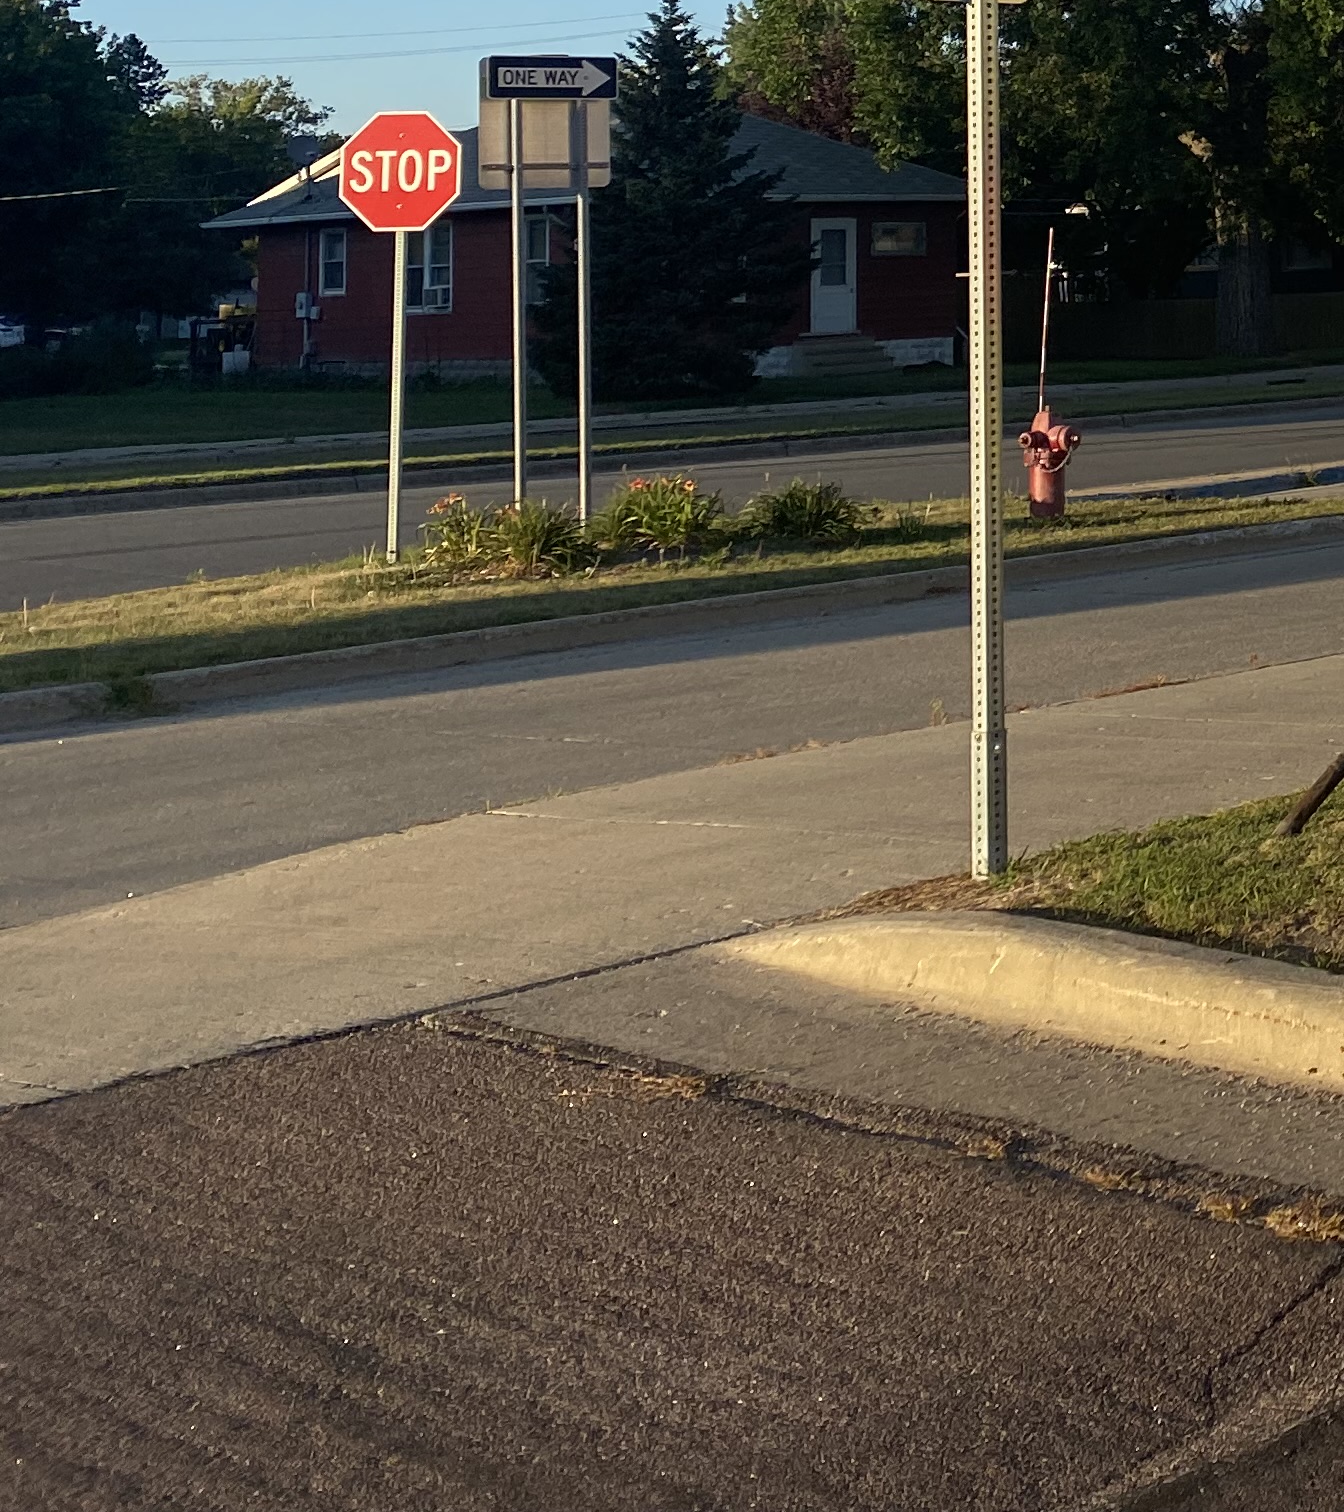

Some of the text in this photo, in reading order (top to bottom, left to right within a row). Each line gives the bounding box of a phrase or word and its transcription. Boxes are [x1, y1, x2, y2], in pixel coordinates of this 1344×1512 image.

[503, 69, 579, 85] ONE WAY
[349, 149, 451, 193] STOP
